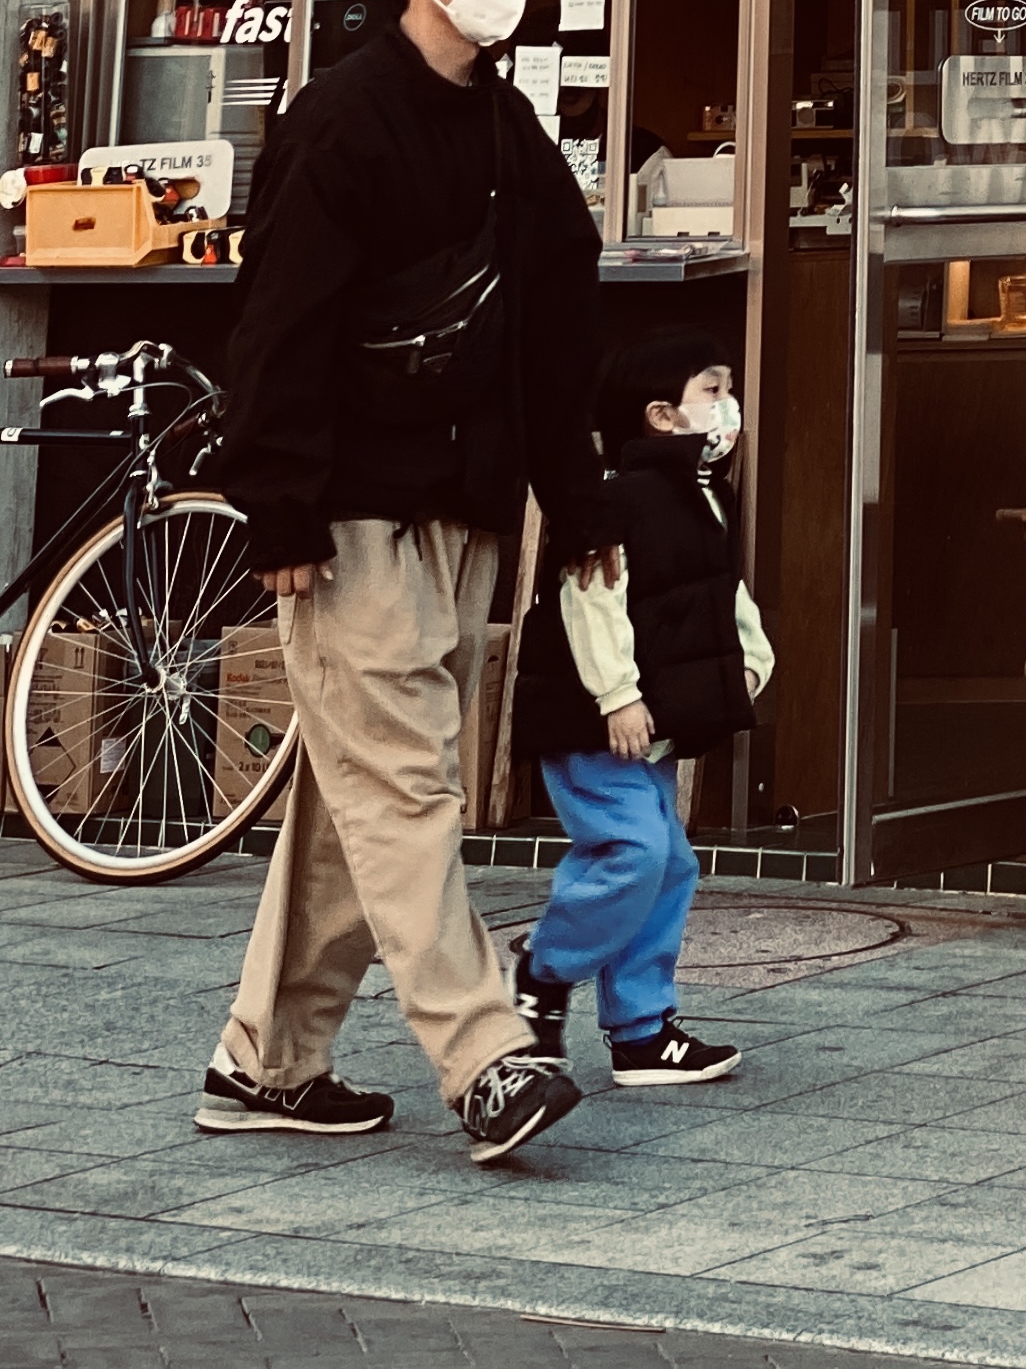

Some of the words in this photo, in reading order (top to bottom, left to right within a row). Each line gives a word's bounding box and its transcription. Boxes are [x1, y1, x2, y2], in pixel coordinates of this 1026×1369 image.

[971, 6, 995, 22] FILM
[996, 6, 1011, 22] TO
[962, 71, 997, 87] HERTZ
[999, 71, 1023, 86] FILM
[160, 155, 193, 170] FILM
[196, 154, 212, 167] 35
